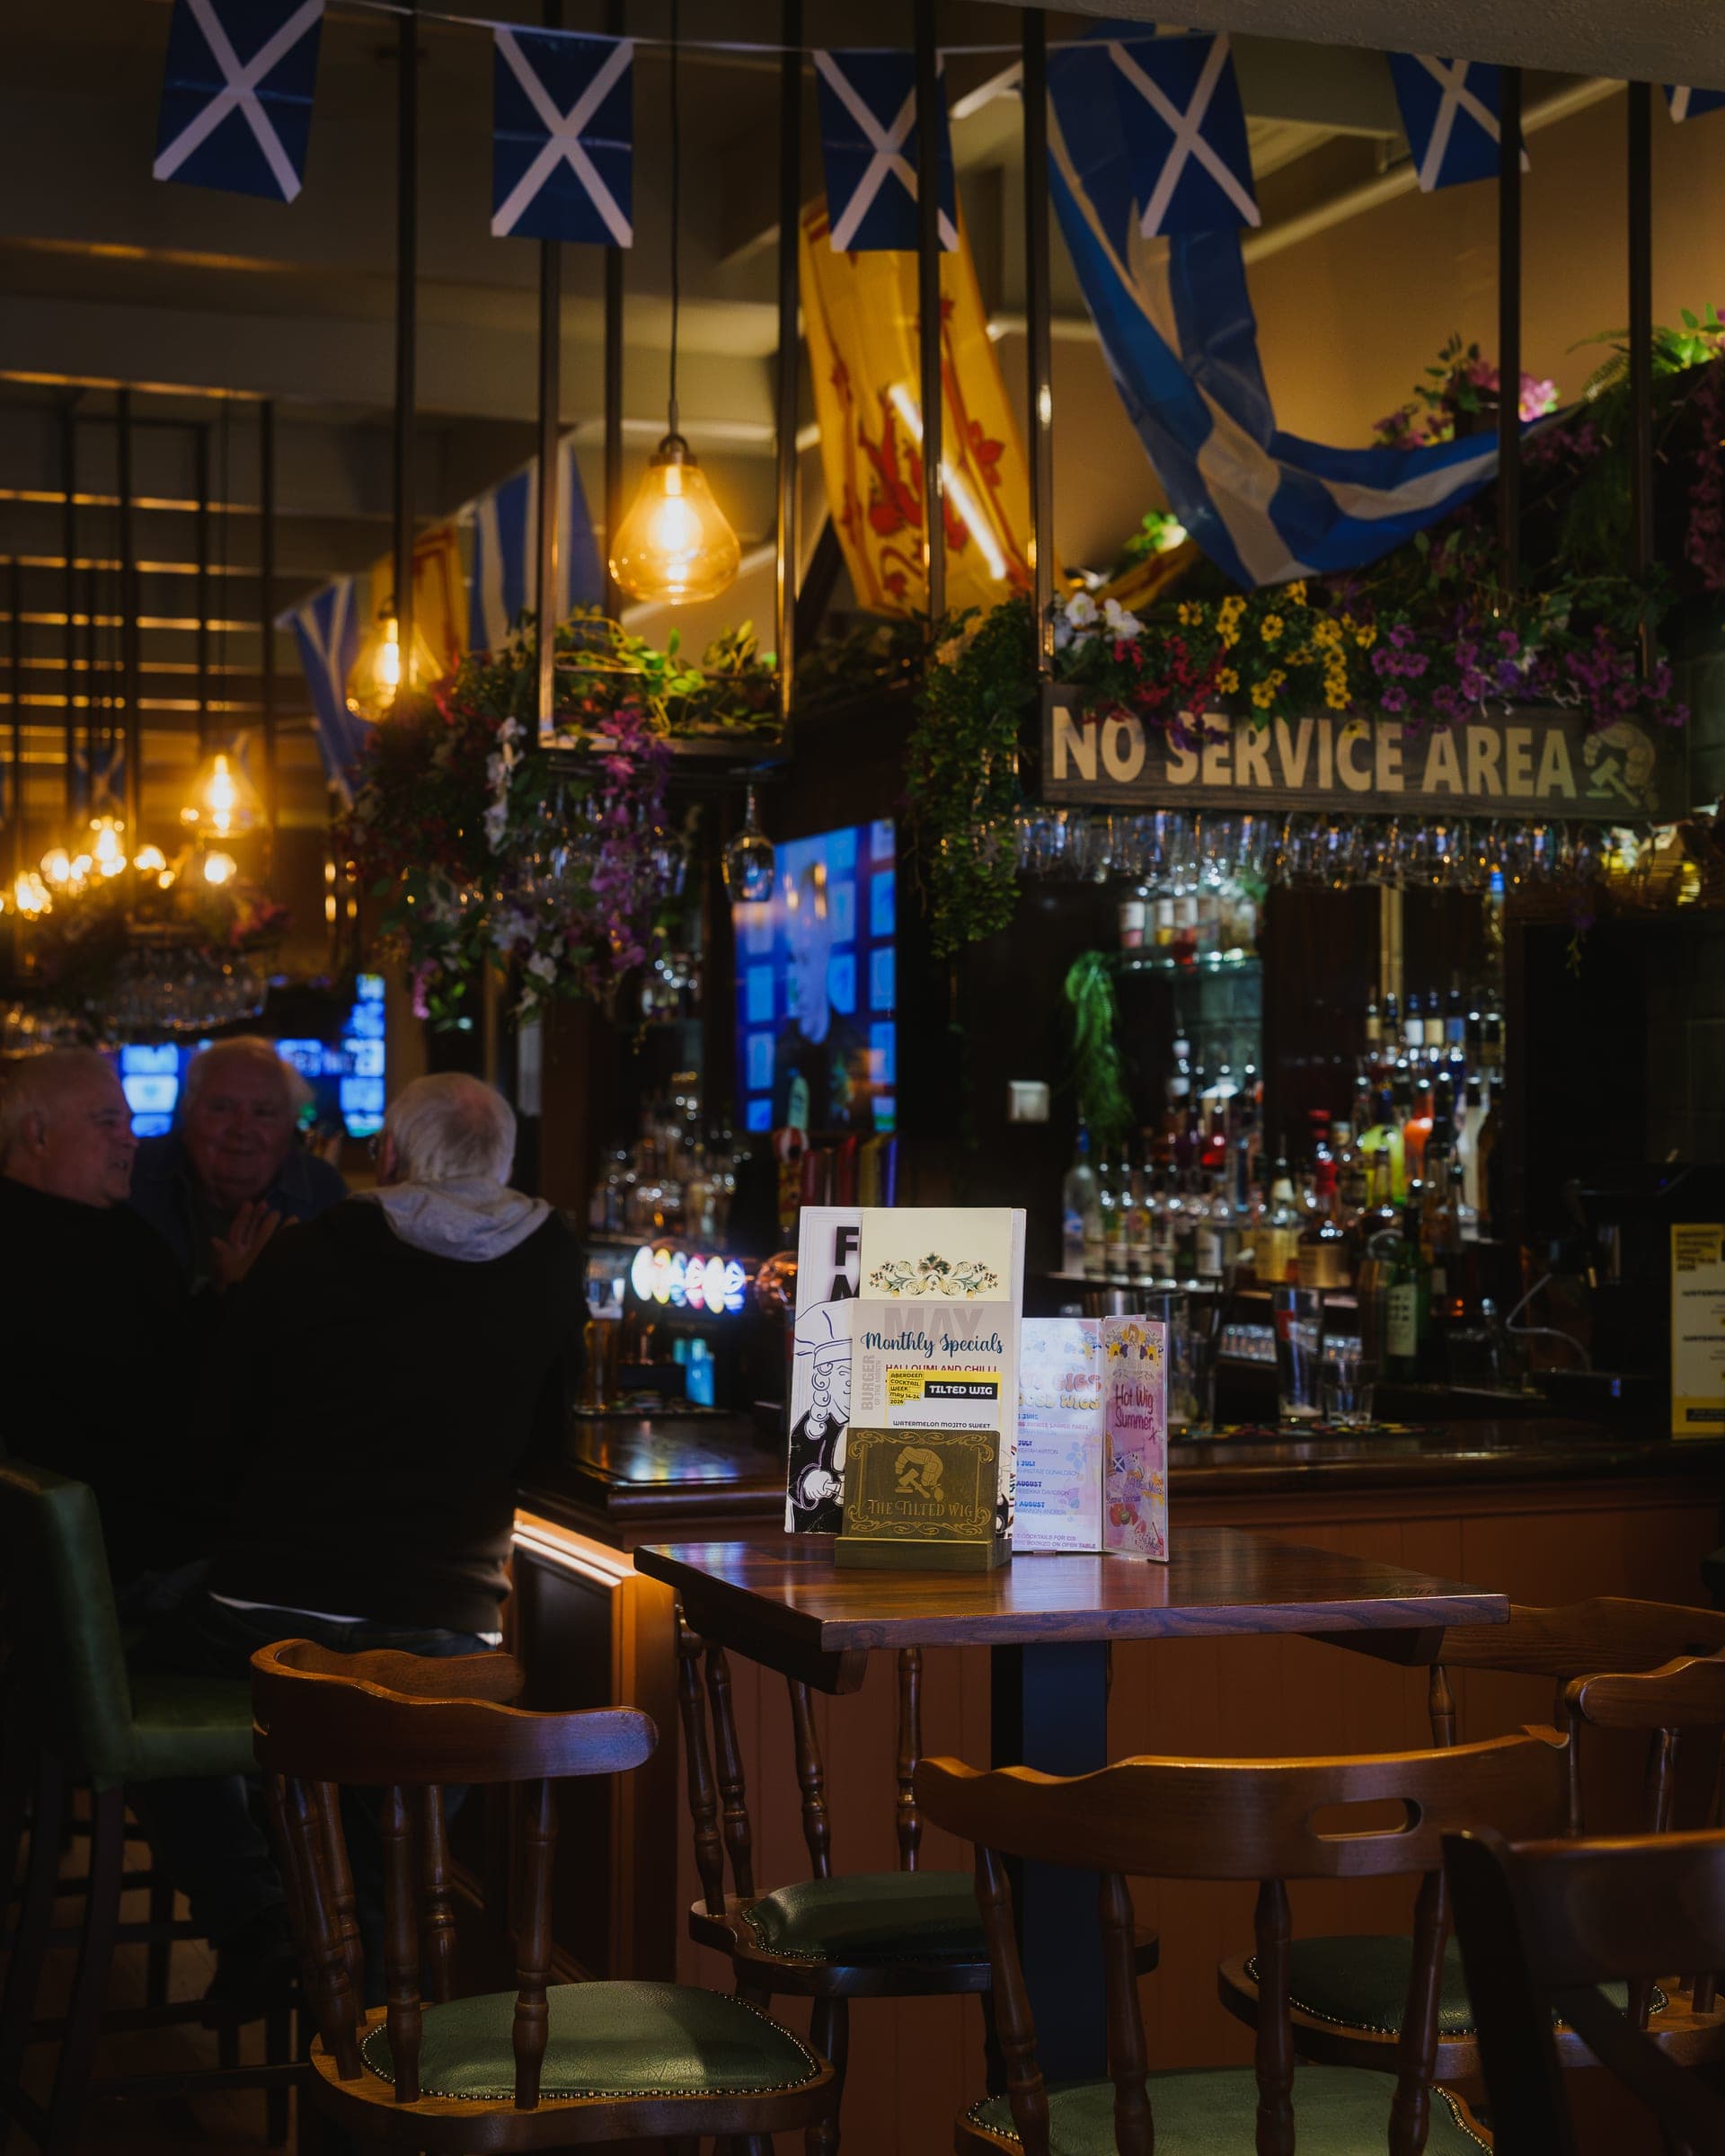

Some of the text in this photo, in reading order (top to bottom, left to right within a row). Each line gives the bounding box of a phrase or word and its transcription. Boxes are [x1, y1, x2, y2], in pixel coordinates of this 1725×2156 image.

[1052, 705, 1578, 799] NO SERVICE AREA
[884, 1307, 984, 1348] MAY
[860, 1330, 1004, 1358] Monthly Specials
[861, 1355, 875, 1410] BURGER
[929, 1385, 993, 1395] TILTED WIG
[1115, 1384, 1154, 1415] Hot Wig
[868, 1499, 973, 1517] THE TILTED WIG
